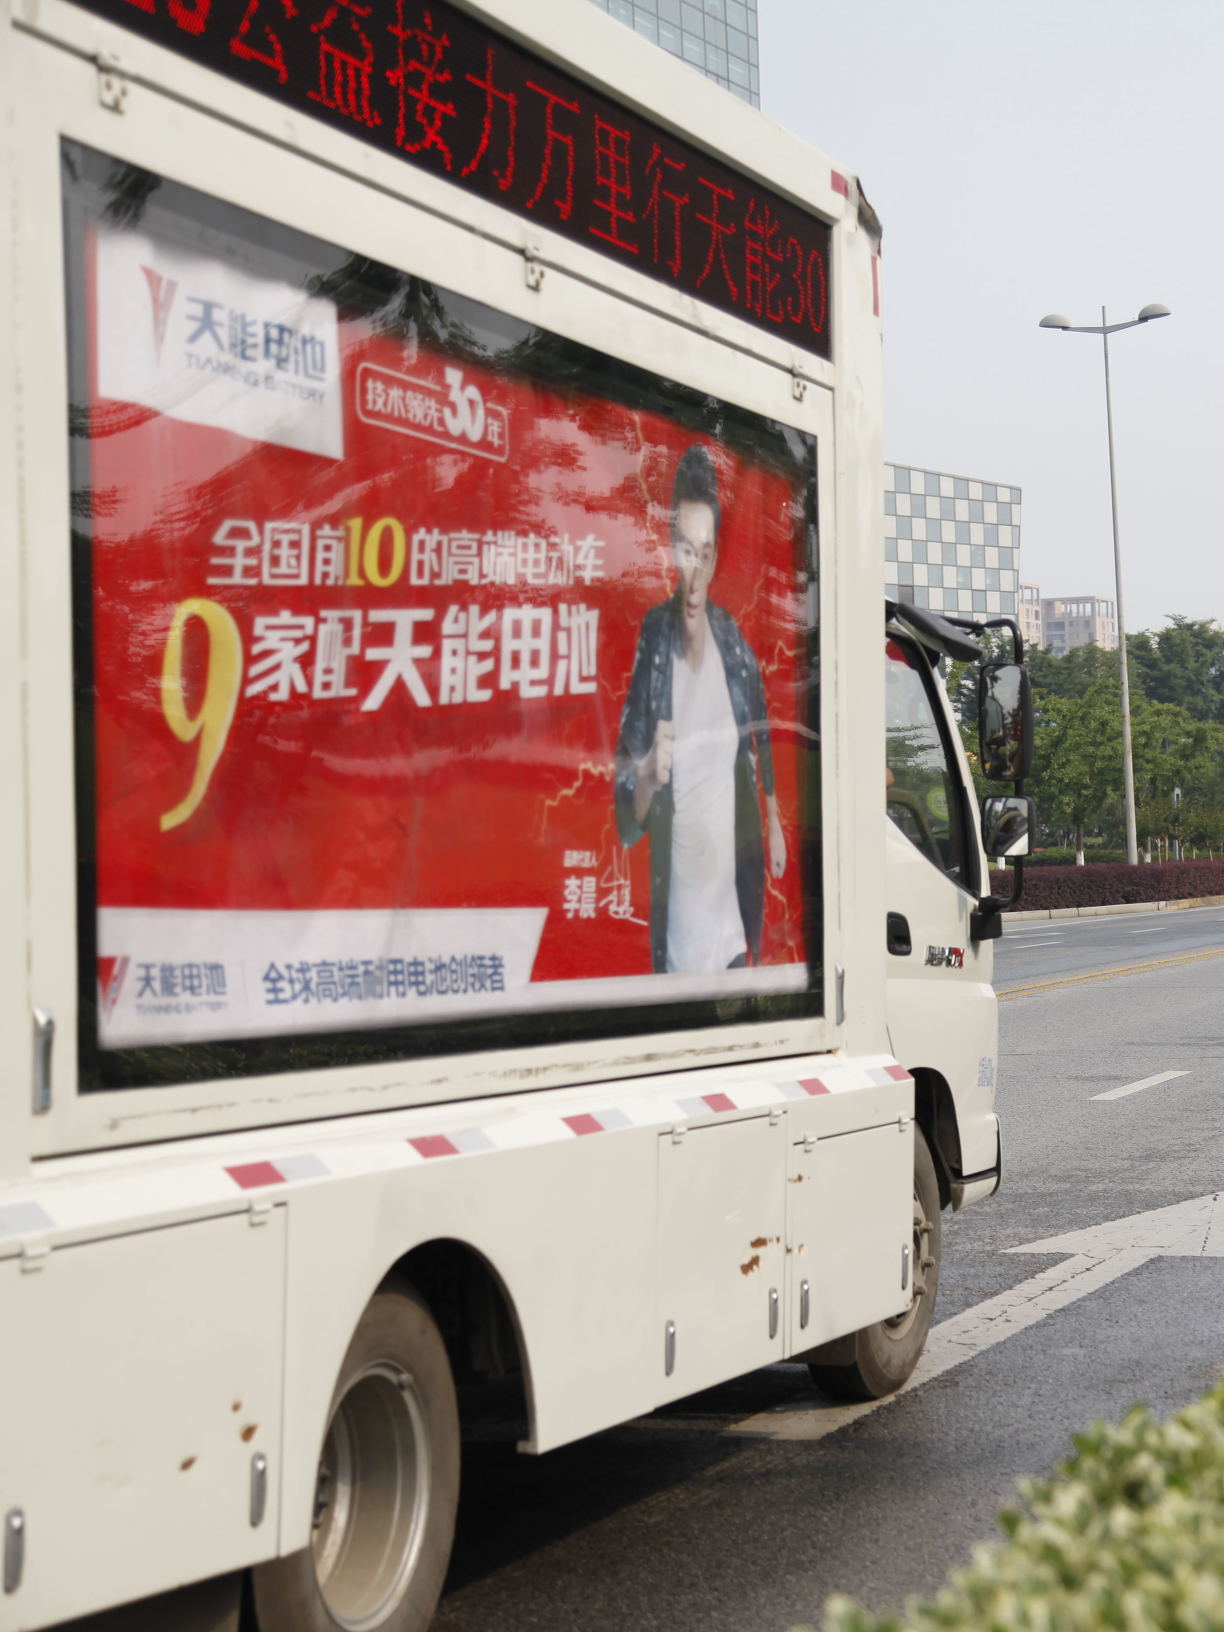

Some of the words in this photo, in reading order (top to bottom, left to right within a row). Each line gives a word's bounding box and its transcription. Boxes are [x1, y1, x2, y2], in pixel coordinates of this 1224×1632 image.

[122, 0, 827, 333] 公益接力万里行天能30
[185, 295, 326, 383] 天能电池
[366, 366, 503, 449] 技术领先30年
[206, 516, 606, 588] 全国前10的高端电动车
[136, 963, 227, 999] 天能电池
